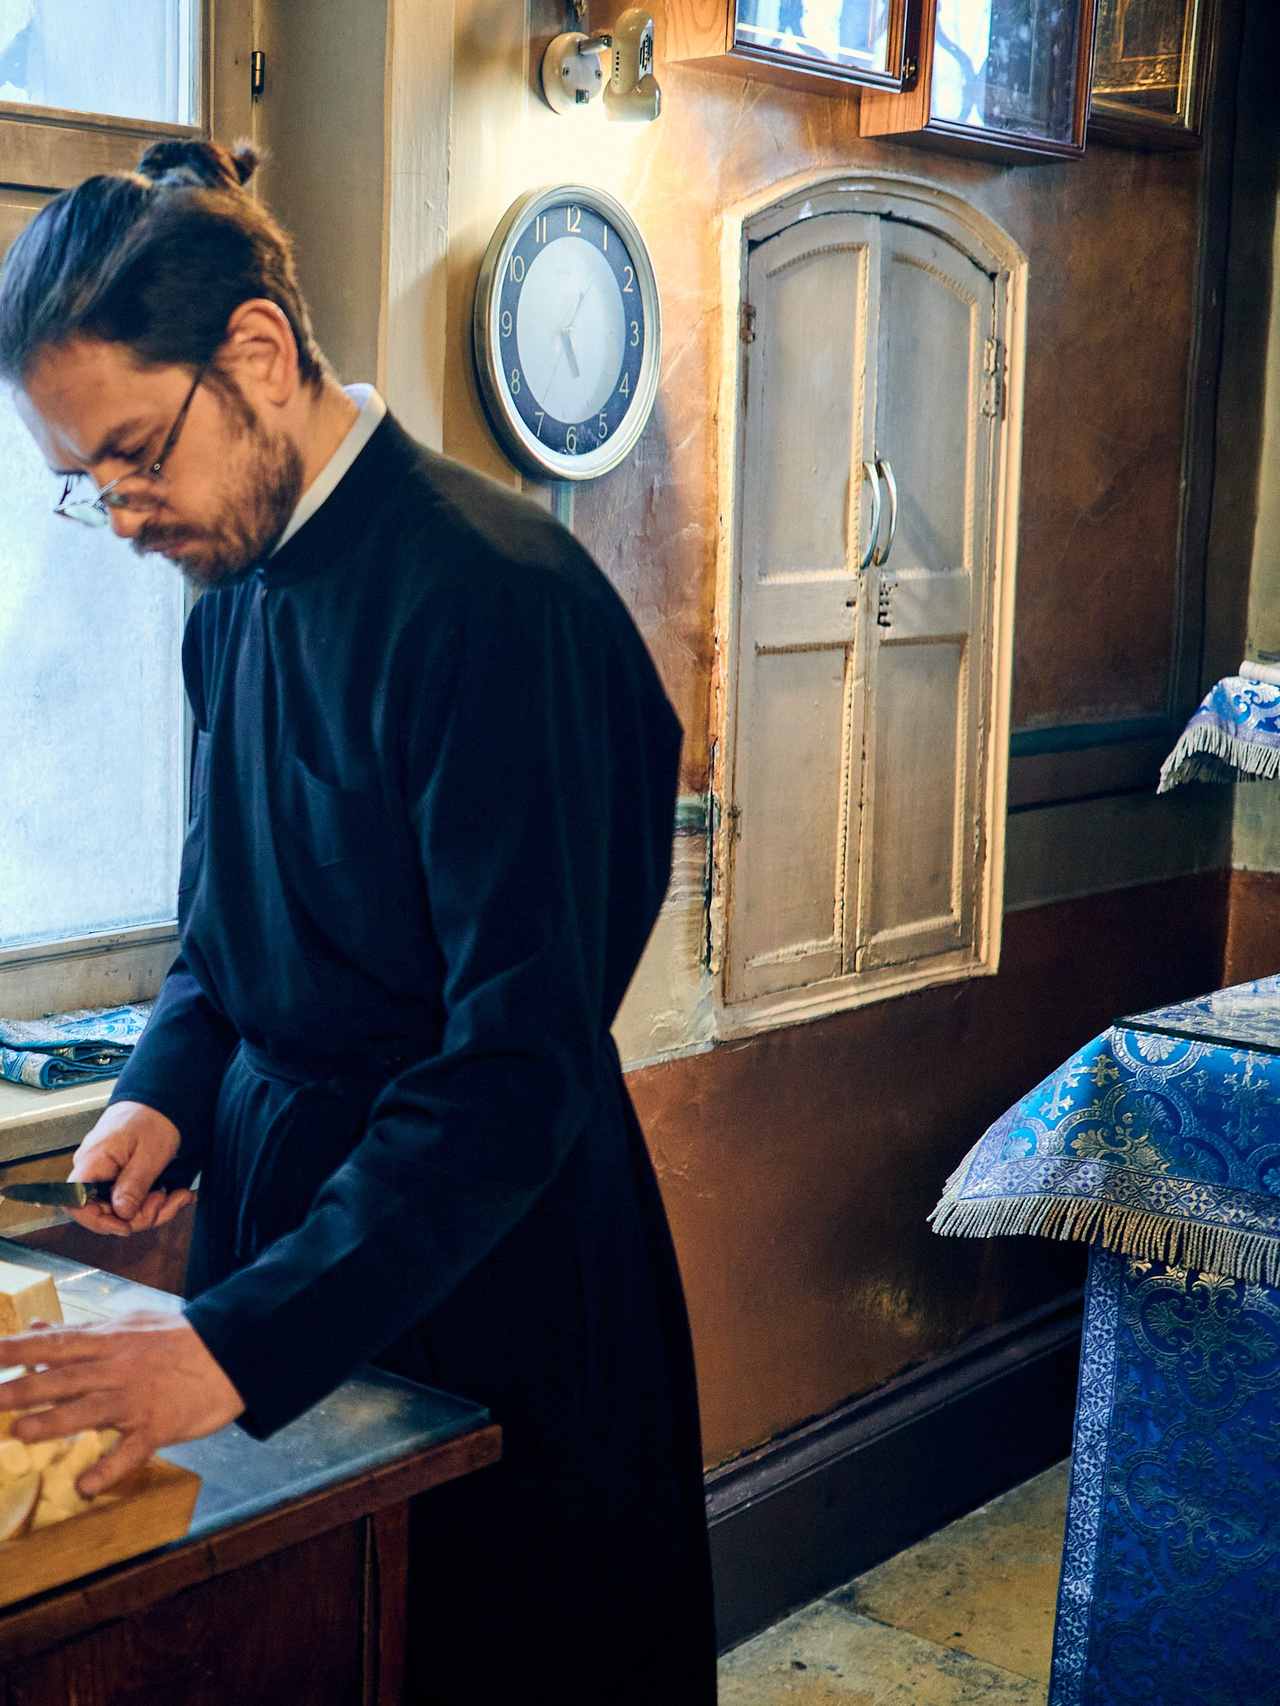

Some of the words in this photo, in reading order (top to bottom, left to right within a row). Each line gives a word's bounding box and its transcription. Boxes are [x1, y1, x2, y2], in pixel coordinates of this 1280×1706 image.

[535, 216, 548, 243] 11
[566, 205, 582, 233] 12
[602, 224, 609, 252] 1
[509, 255, 525, 283] 10
[622, 265, 634, 293] 2
[501, 310, 513, 338] 9
[630, 320, 640, 347] 3
[510, 368, 521, 395] 8
[618, 372, 630, 398] 4
[534, 411, 545, 437] 7
[598, 412, 608, 439] 5
[566, 425, 577, 452] 6
